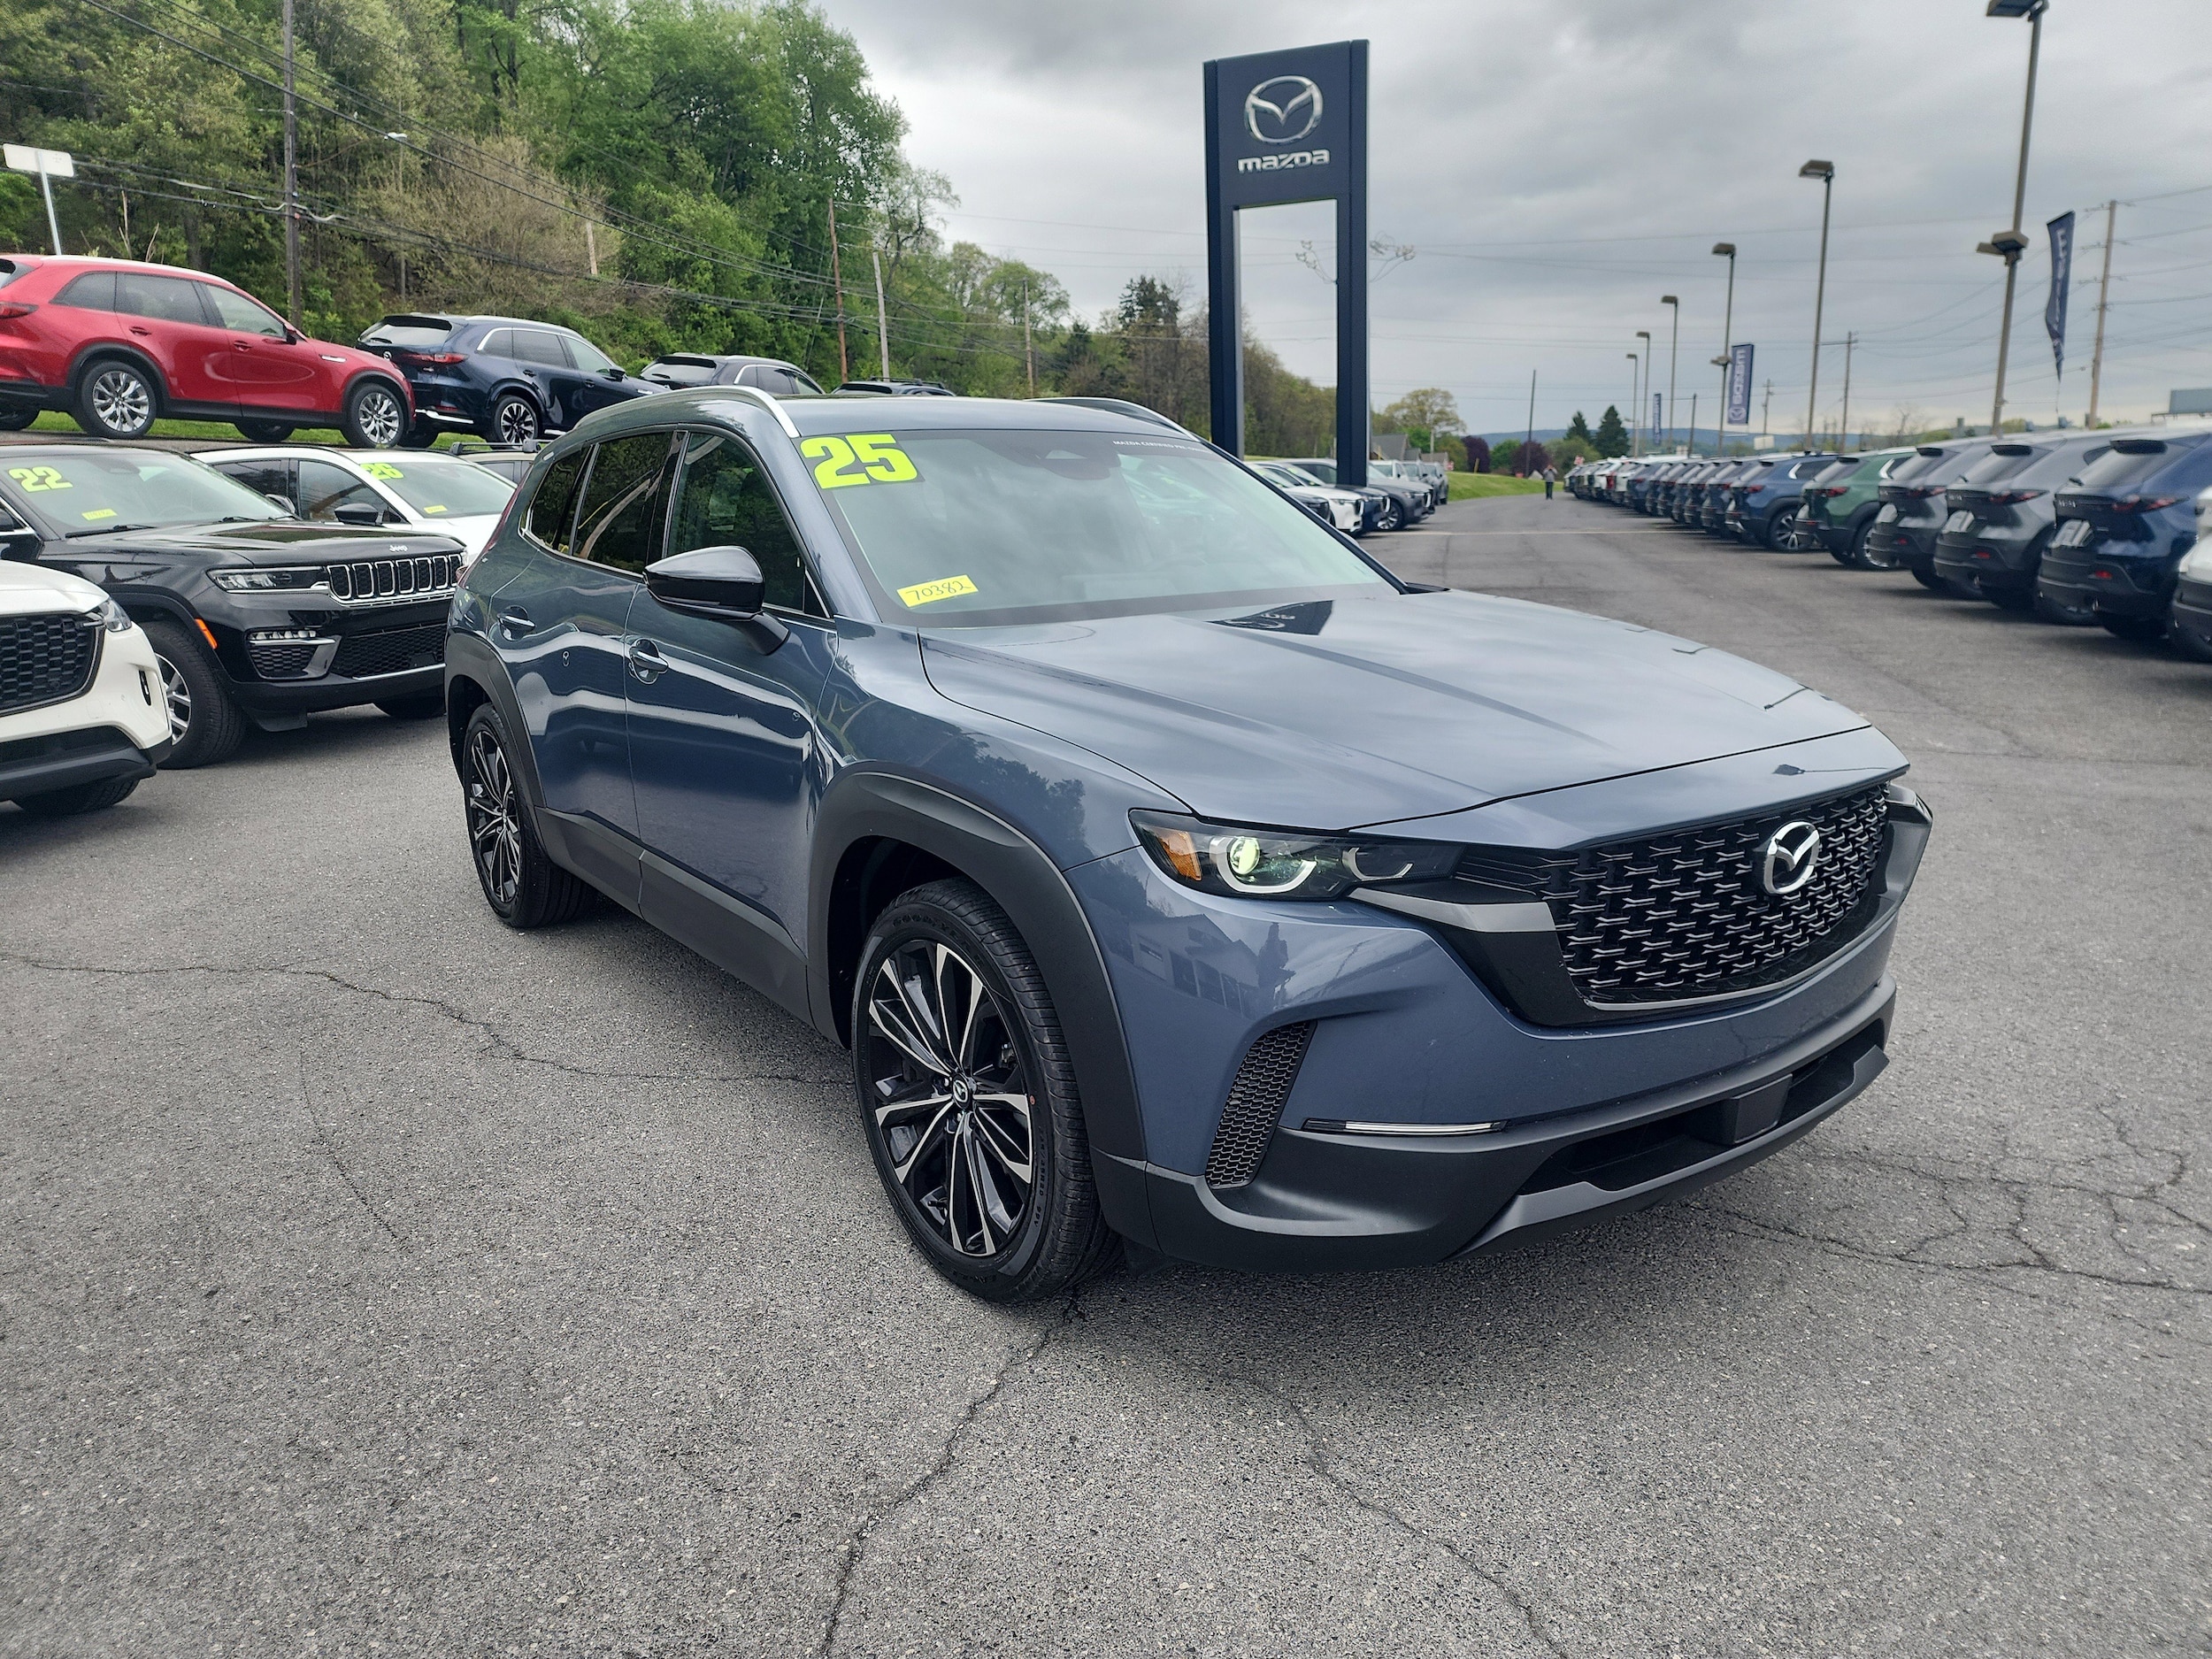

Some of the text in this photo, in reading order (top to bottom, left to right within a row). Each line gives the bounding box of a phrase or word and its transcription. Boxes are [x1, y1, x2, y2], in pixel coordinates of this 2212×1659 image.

[1238, 149, 1331, 173] mazda
[359, 462, 404, 480] 26
[800, 433, 918, 489] 25
[8, 465, 73, 493] 22
[905, 580, 972, 601] 70382
